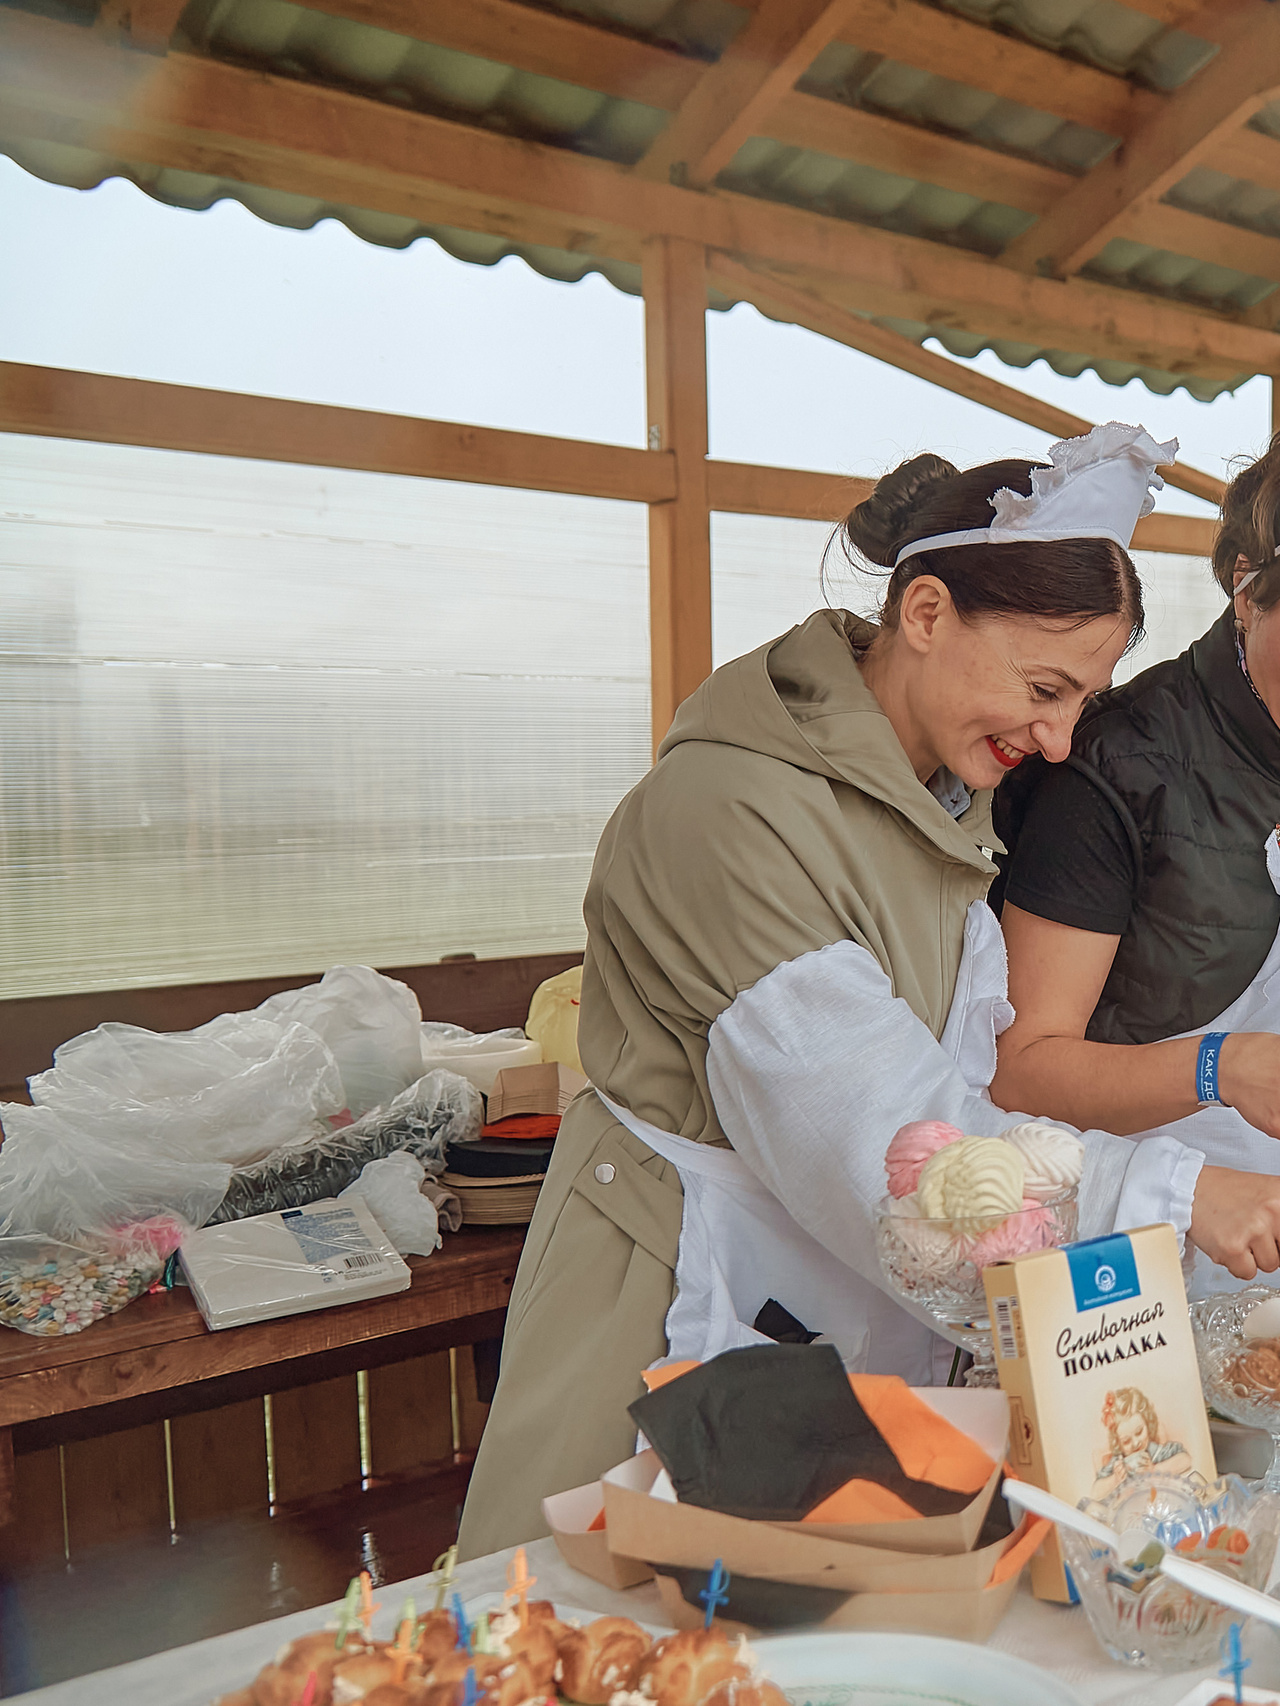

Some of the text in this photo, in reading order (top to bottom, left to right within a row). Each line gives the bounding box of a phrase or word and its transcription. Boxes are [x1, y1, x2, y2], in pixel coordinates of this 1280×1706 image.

[1205, 1049, 1216, 1078] КАК
[1056, 1301, 1165, 1358] Сливочная
[1063, 1330, 1168, 1377] ПОМАДКА
